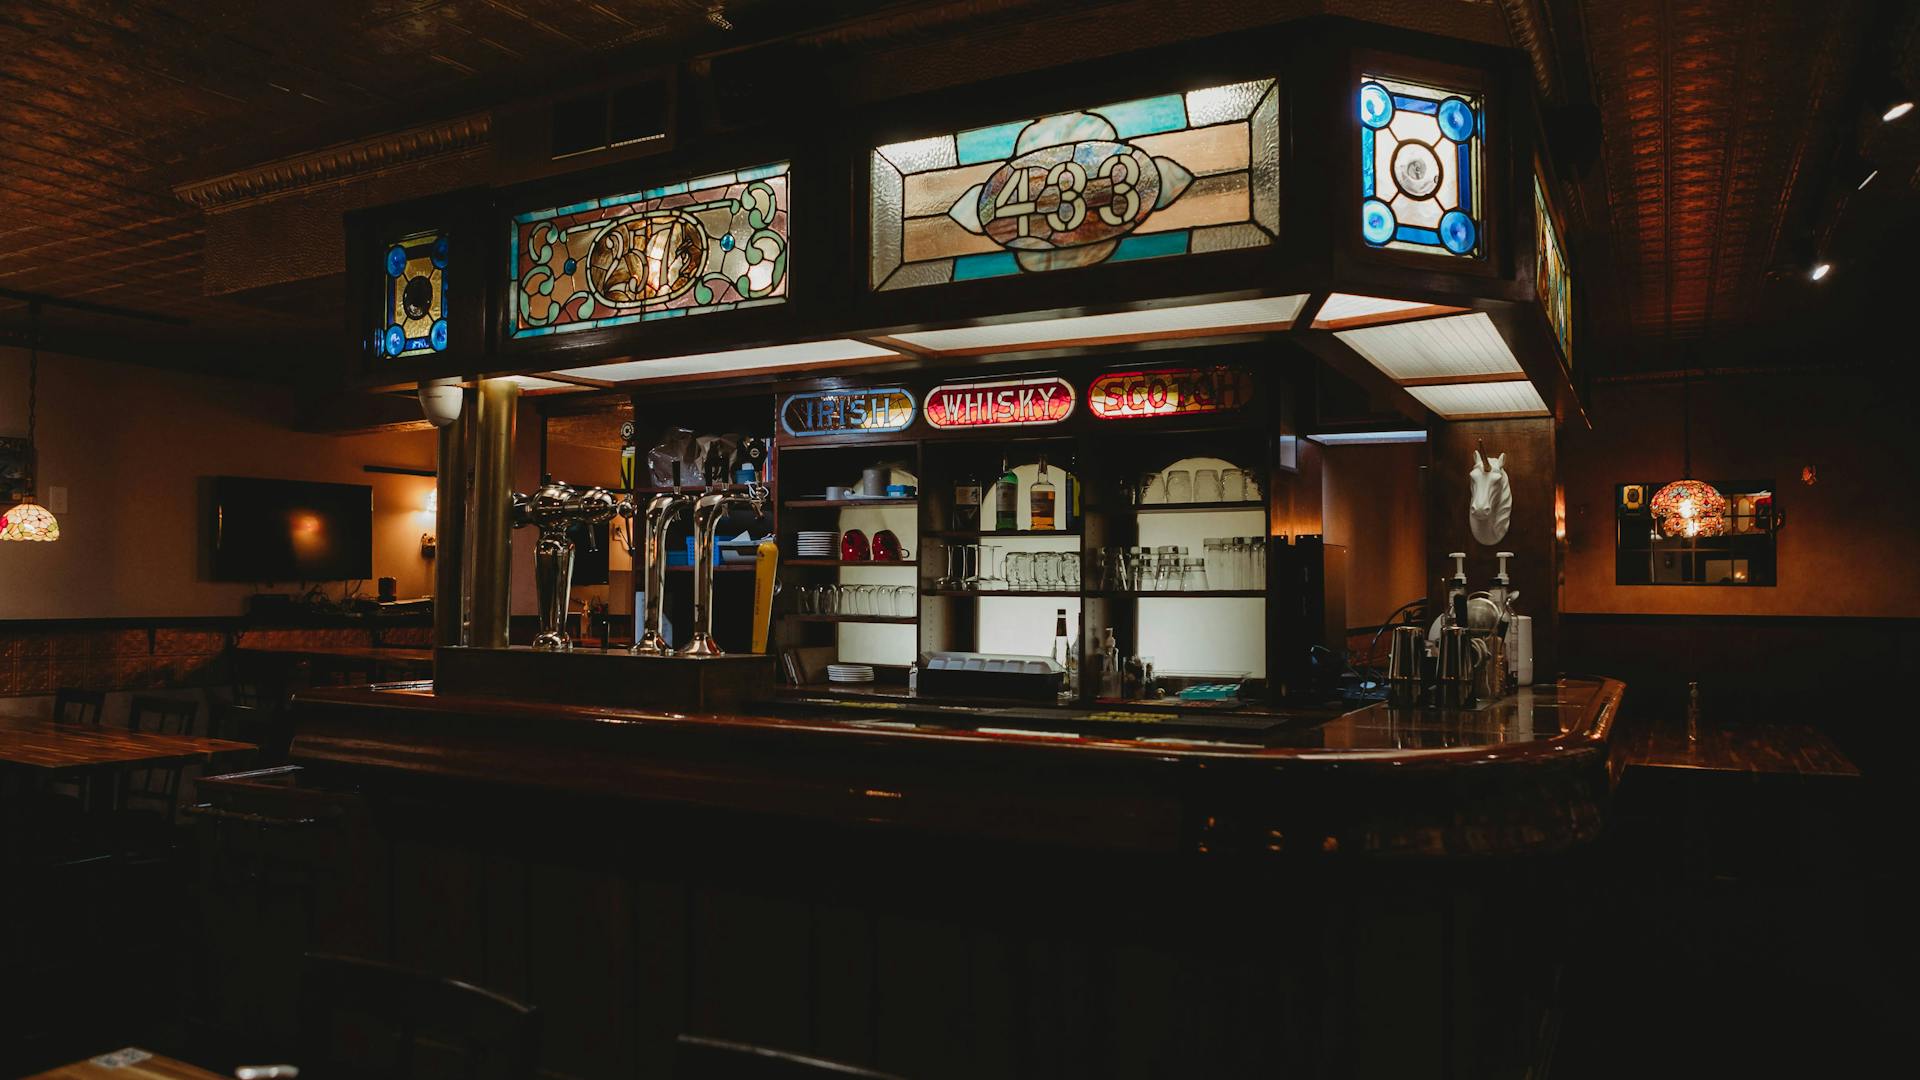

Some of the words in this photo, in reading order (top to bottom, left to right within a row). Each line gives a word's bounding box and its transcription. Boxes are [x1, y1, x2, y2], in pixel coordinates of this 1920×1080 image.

[995, 154, 1141, 237] 433
[806, 397, 890, 428] IRISH
[942, 387, 1057, 422] WHISKY
